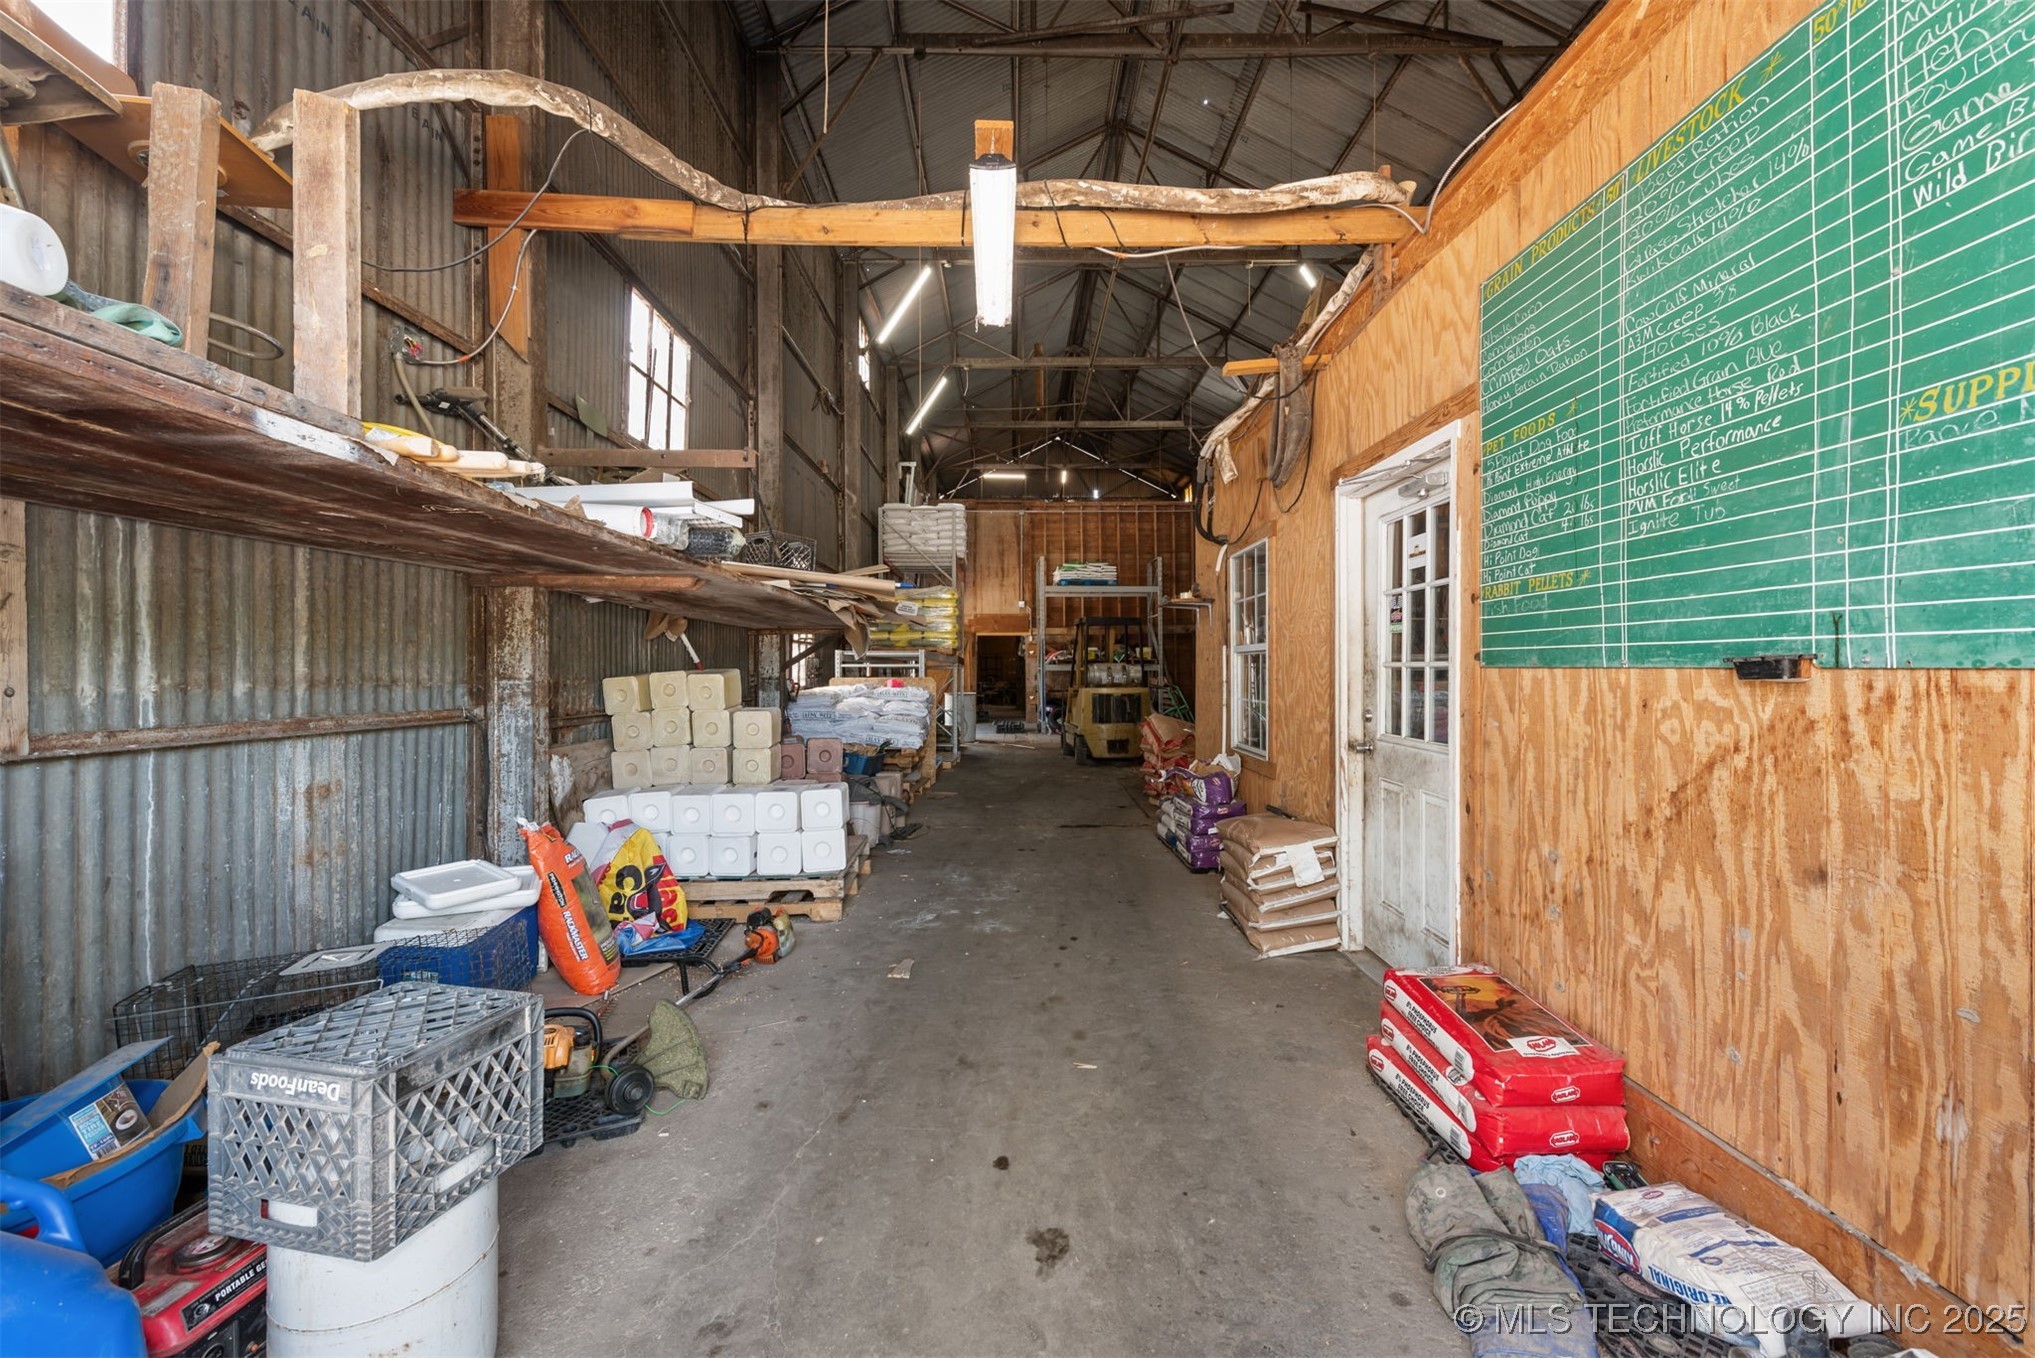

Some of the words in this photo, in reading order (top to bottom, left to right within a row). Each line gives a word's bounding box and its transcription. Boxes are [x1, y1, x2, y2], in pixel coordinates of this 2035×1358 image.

[1904, 27, 1990, 94] Hen
[1634, 75, 1746, 183] LIVESTOCK
[1691, 96, 1770, 158] Ration
[1693, 125, 1760, 180] Creep
[1905, 122, 1993, 181] Game
[1689, 154, 1755, 206] Cubes
[1913, 160, 1967, 208] Wild
[1485, 257, 1523, 299] GRAIN
[1530, 200, 1596, 266] PRODUCTS
[1693, 252, 1757, 298] Mineral
[1514, 301, 1543, 325] Corn
[1535, 334, 1571, 365] Oats
[1628, 353, 1691, 391] Fortified
[1751, 304, 1801, 337] Black
[1642, 315, 1721, 364] Horses
[1625, 378, 1691, 417] Fortified
[1693, 361, 1739, 390] Grain
[1746, 340, 1788, 370] Blue
[1707, 375, 1755, 404] Horse
[1767, 354, 1801, 383] Red
[1669, 413, 1712, 440] Horse
[1755, 382, 1803, 413] Pellets
[1485, 436, 1505, 456] PET
[1513, 411, 1556, 443] FOODS
[1529, 438, 1553, 458] Dog
[1680, 415, 1783, 459] Performance
[1678, 458, 1722, 487] Elite
[1703, 474, 1741, 498] Sweet
[1524, 490, 1557, 511] Puppy
[1628, 509, 1680, 537] Ignite
[1691, 498, 1726, 522] Tub
[1483, 513, 1529, 539] Diamond
[1495, 550, 1517, 565] Point
[1519, 546, 1538, 560] Dog
[1495, 565, 1517, 581] Point
[1517, 562, 1537, 576] Cat
[1484, 581, 1521, 599] RABBIT
[1528, 571, 1574, 593] PELLETS
[548, 872, 566, 908] PENNINGTON
[562, 910, 589, 961] RACKMASTER
[1411, 1006, 1438, 1034] PHOSPHORUS
[1412, 1050, 1440, 1082] PHOSPHORUS
[1401, 1079, 1430, 1109] PHOSPHORUS
[214, 1269, 255, 1302] PORTABLE
[255, 1259, 267, 1272] GE
[1648, 1265, 1710, 1304] ORIGINAL
